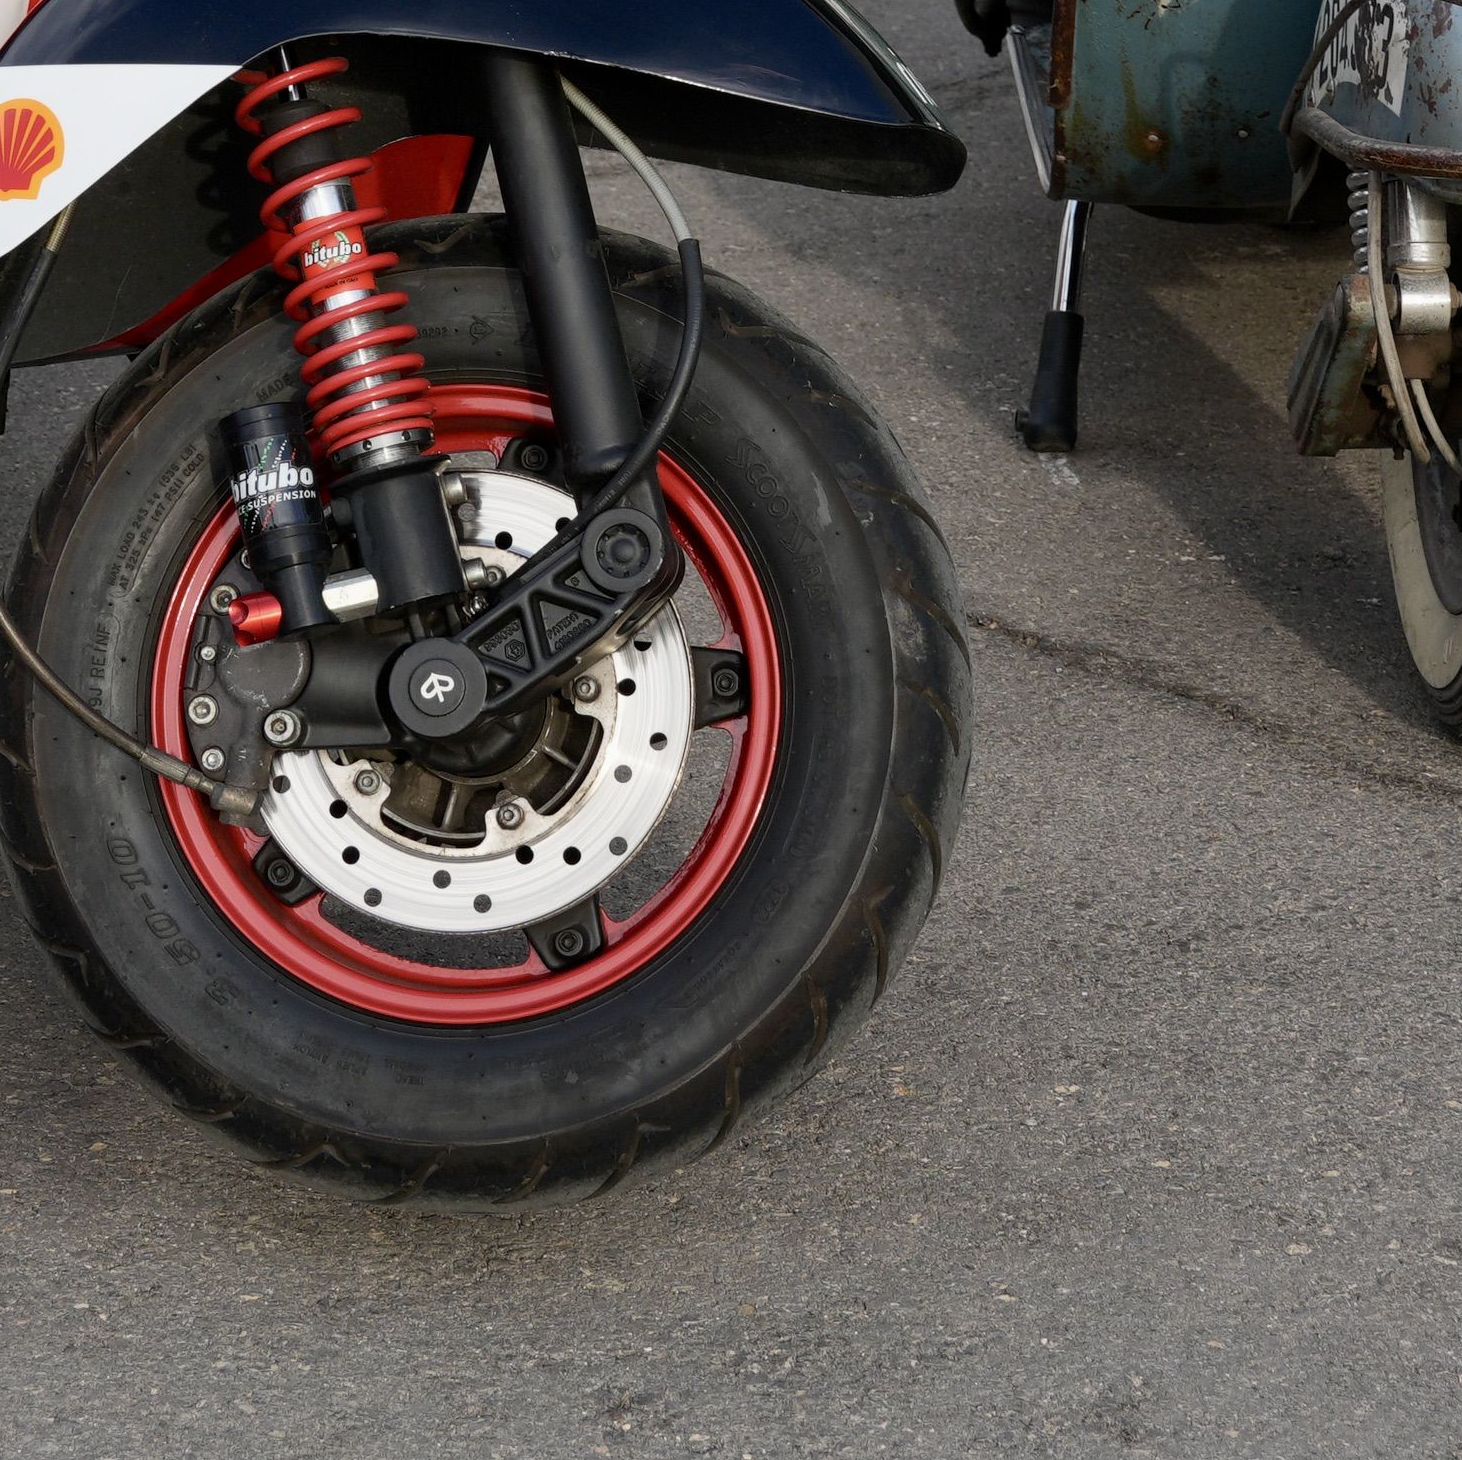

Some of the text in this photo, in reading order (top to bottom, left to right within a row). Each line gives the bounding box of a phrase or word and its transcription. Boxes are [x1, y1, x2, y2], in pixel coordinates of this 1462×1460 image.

[304, 241, 362, 267] bitubo
[230, 462, 314, 504] bitubo
[247, 489, 317, 511] SUSPENSION
[119, 574, 130, 590] AT
[125, 550, 140, 572] 325
[183, 453, 205, 478] COLD
[117, 531, 136, 560] LOAD
[90, 622, 112, 683] REINF
